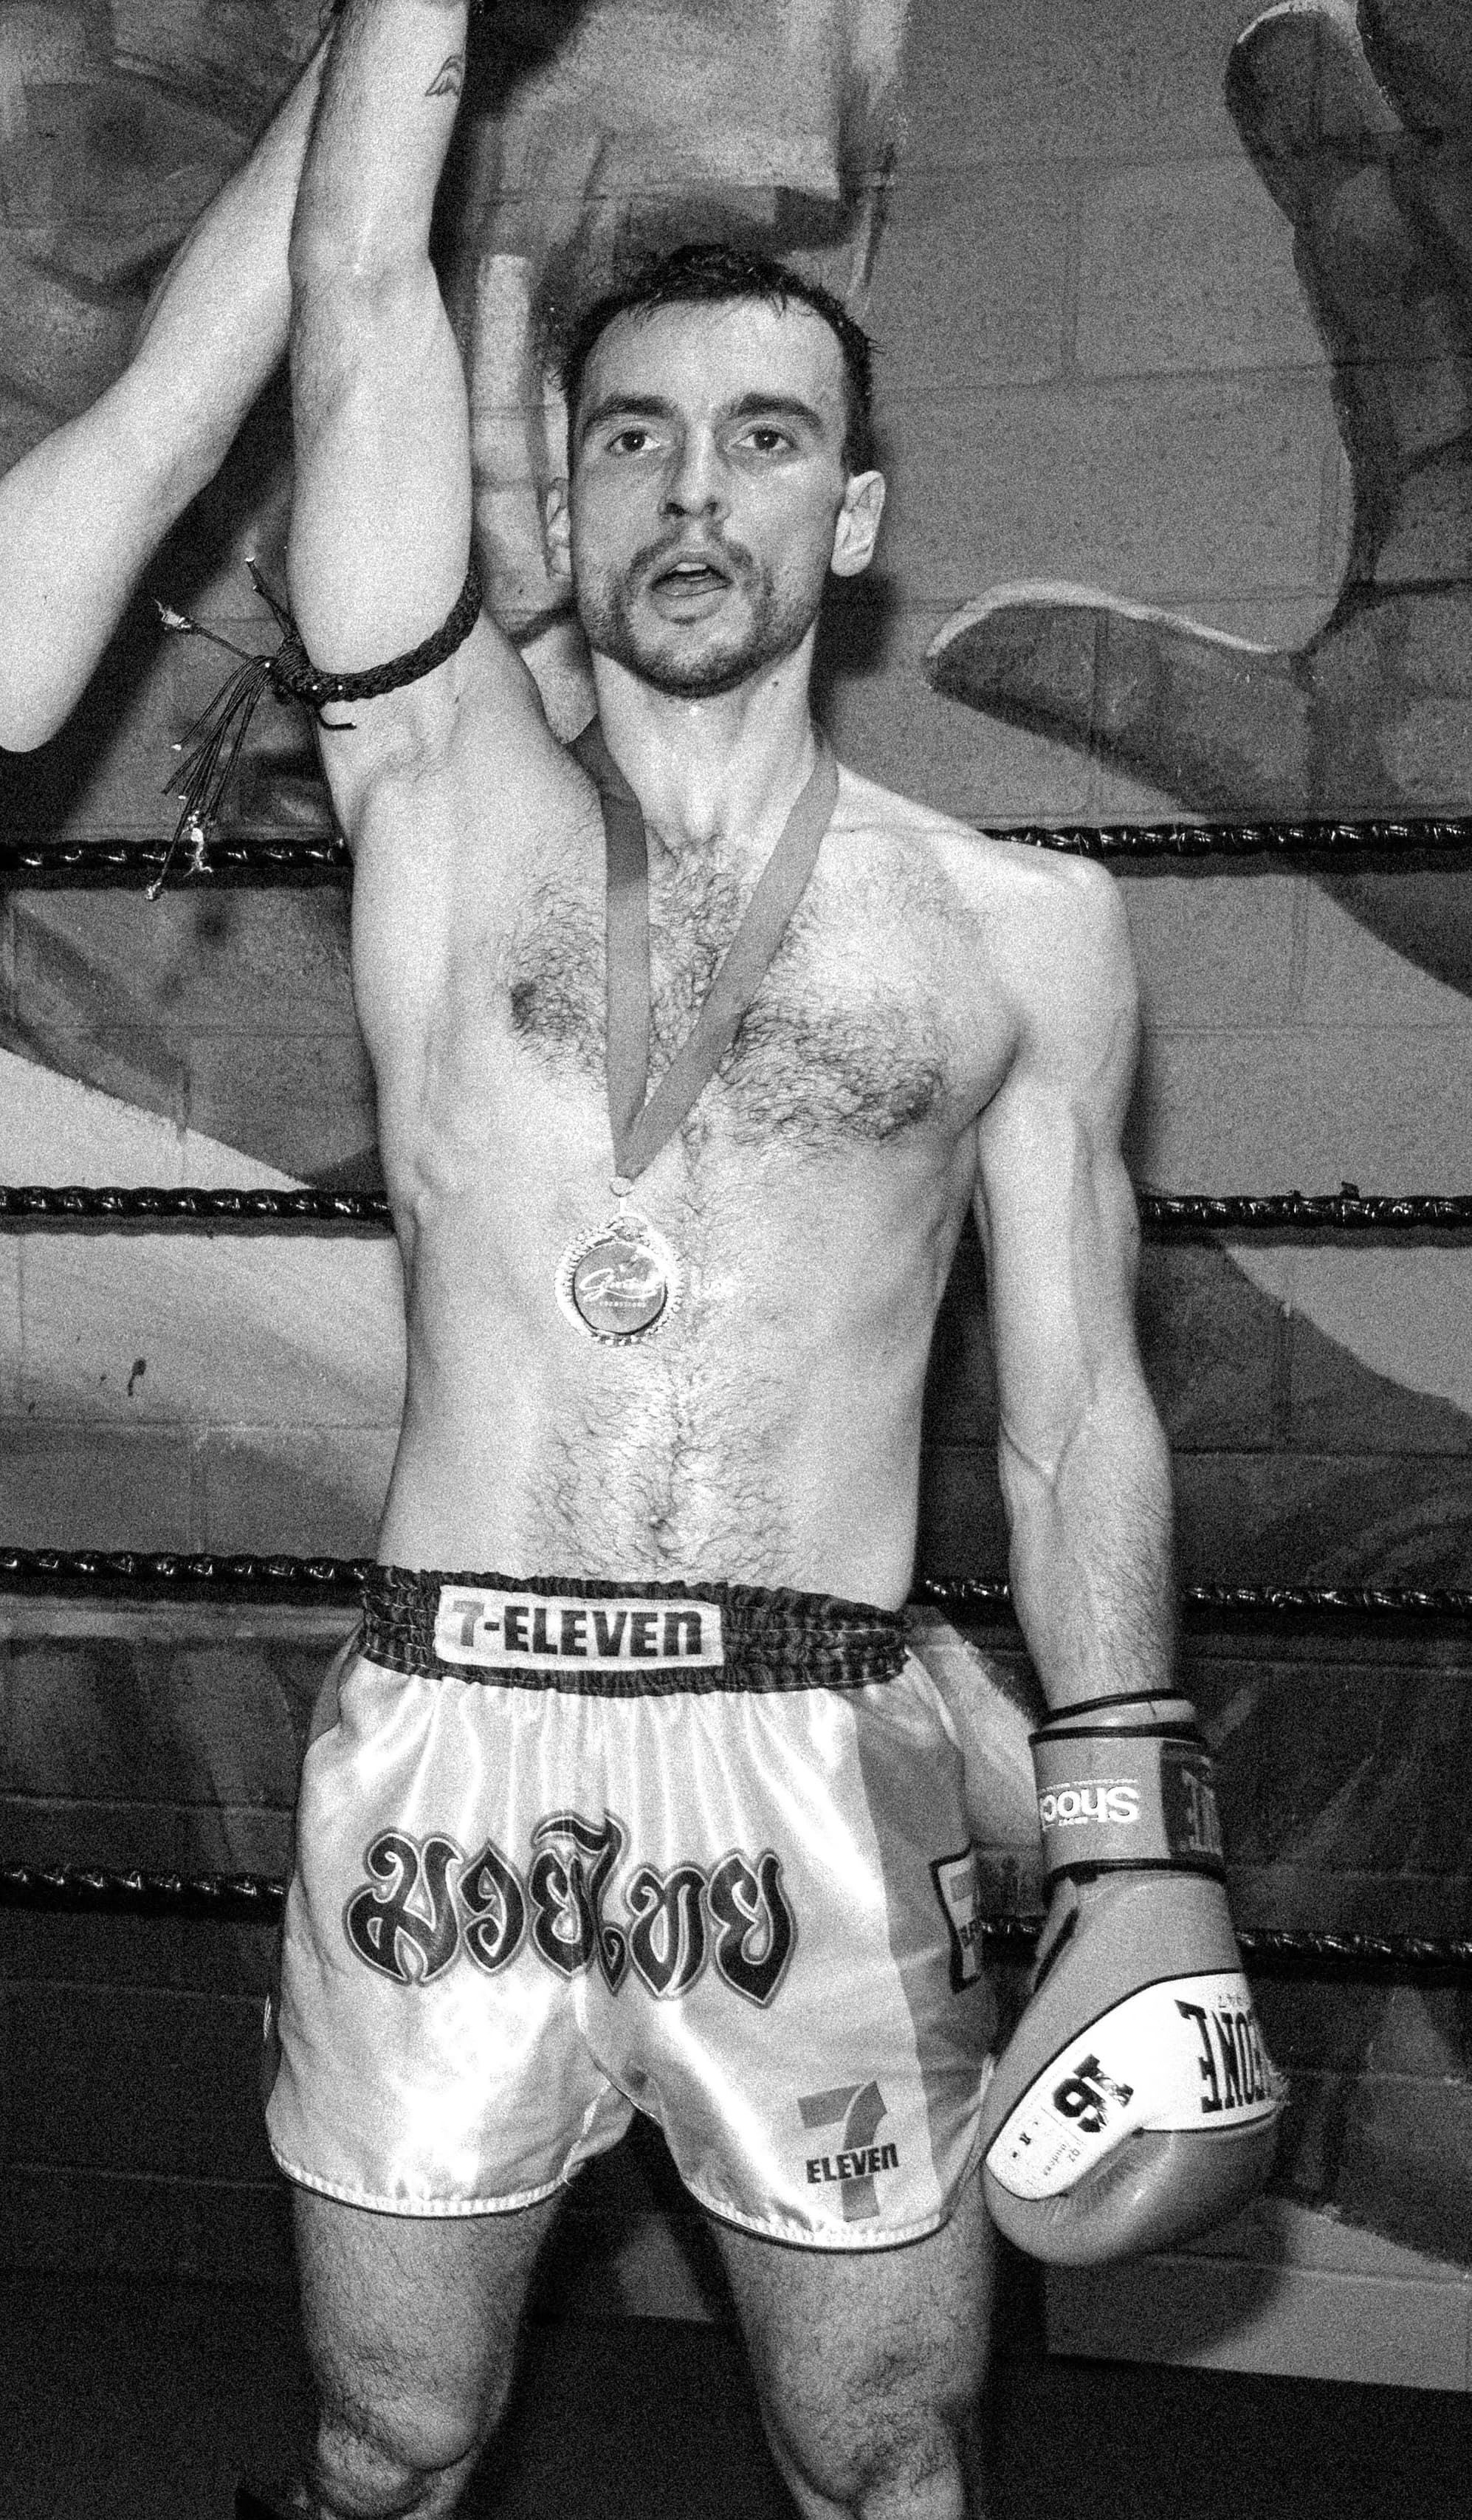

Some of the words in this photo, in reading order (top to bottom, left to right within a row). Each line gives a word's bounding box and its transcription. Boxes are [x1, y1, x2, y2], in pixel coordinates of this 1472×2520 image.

[345, 1810, 797, 2007] มวยไทย
[1052, 2053, 1135, 2133] 16
